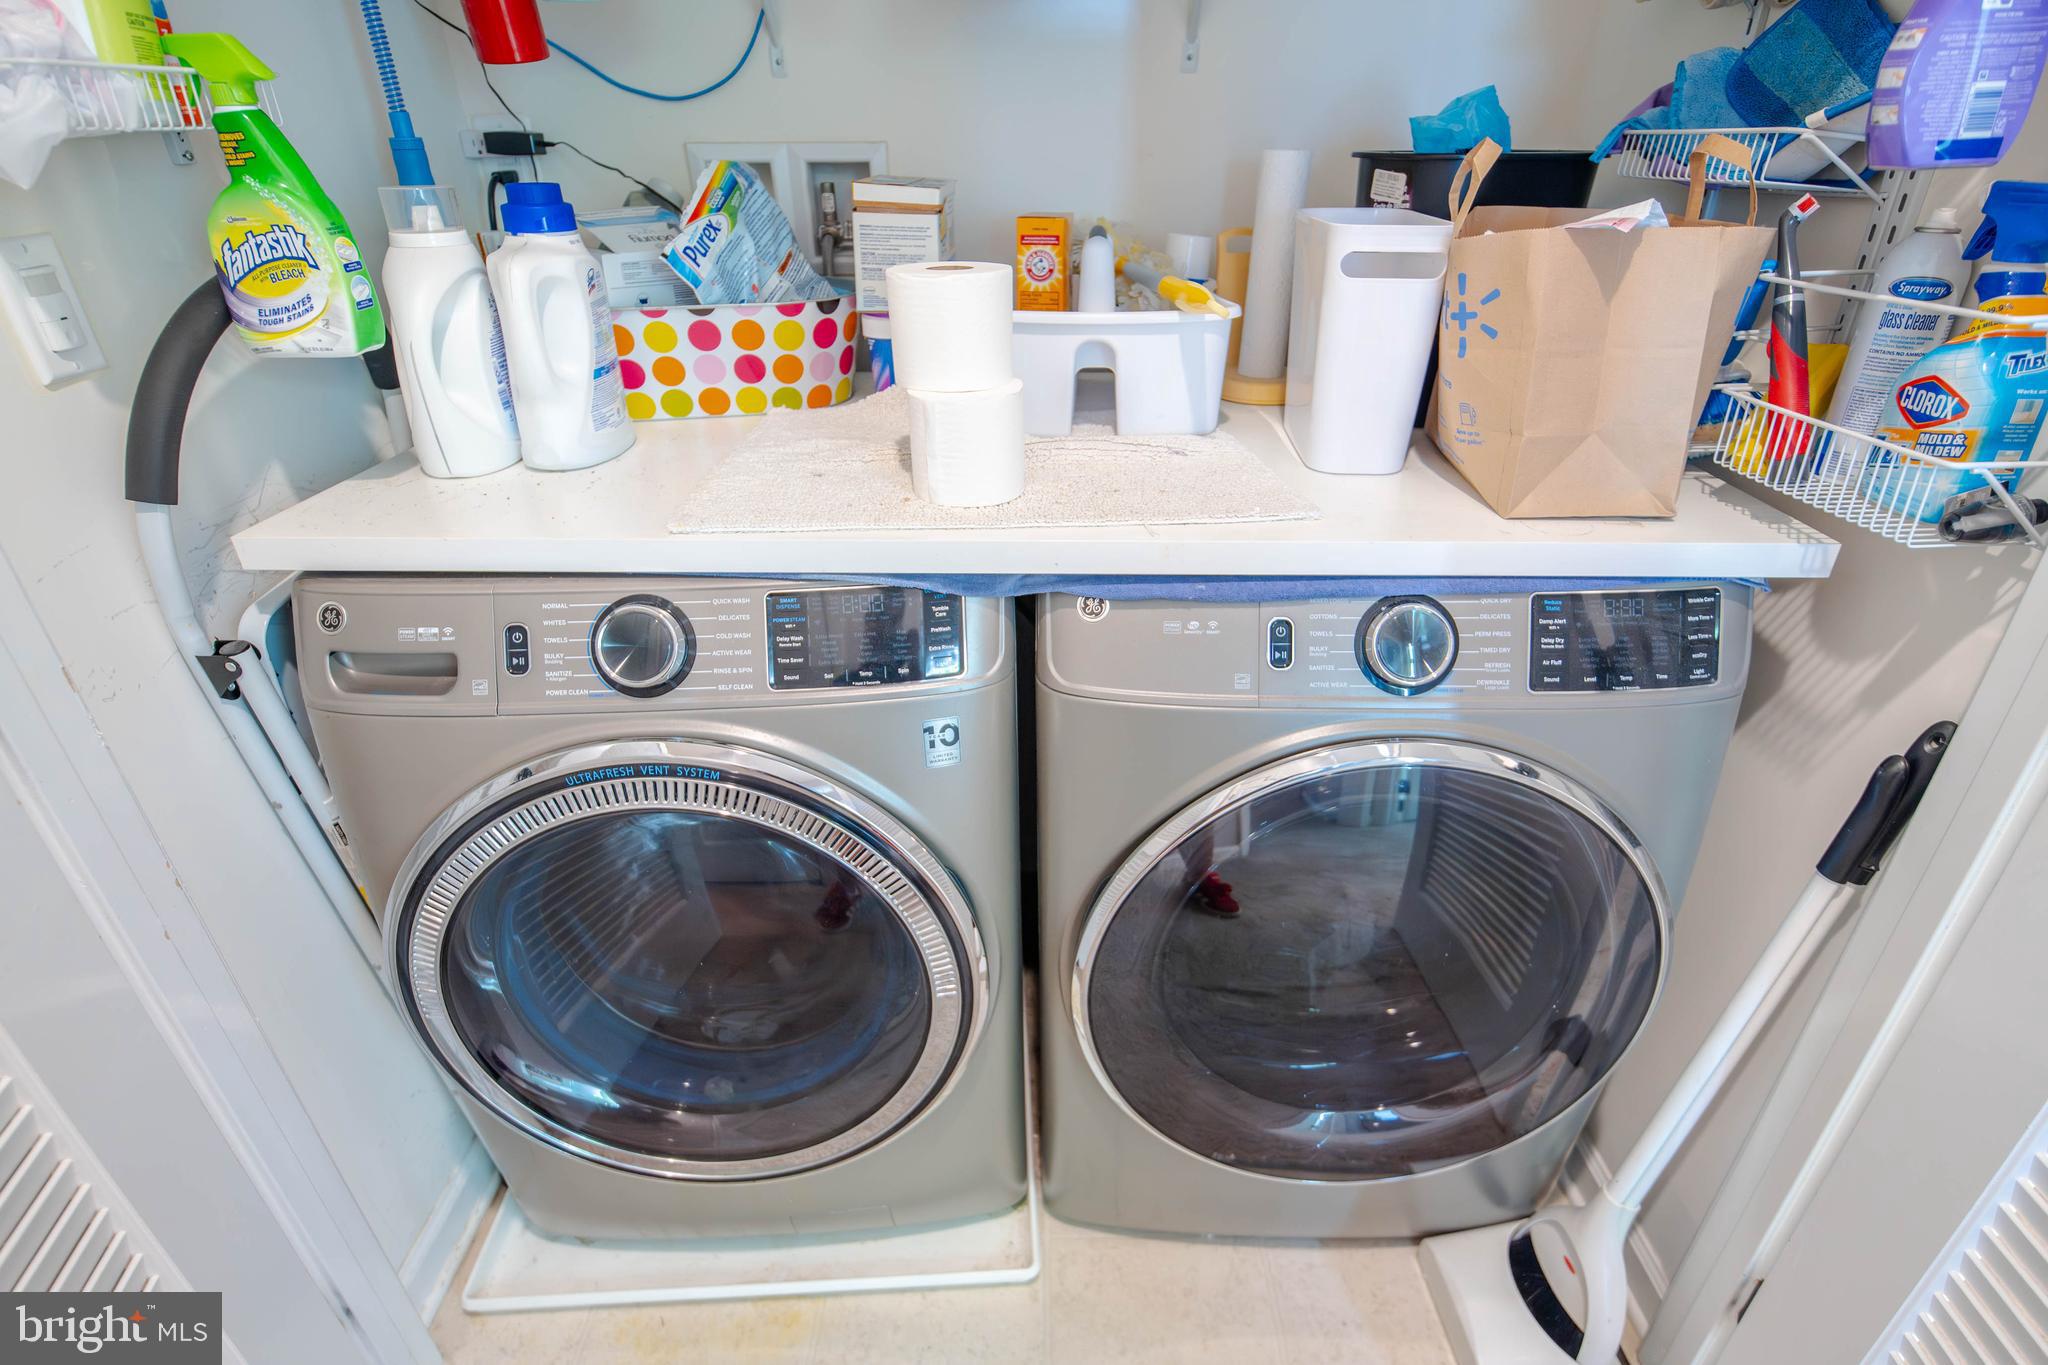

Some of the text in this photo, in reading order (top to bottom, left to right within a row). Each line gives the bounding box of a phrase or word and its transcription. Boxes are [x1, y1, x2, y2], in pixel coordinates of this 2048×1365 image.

[682, 219, 722, 267] Purex
[221, 224, 320, 293] fantastik
[269, 268, 306, 284] BLEACH
[1897, 281, 1947, 297] Sprayway
[257, 293, 312, 318] ELIMINATES
[258, 303, 315, 326] TOUGH STAINS
[1878, 309, 1941, 331] glass cleaner
[1899, 385, 1959, 420] CLOROX
[1918, 432, 1966, 445] MOLD &
[897, 667, 910, 675] Spin
[922, 723, 960, 749] 10
[565, 765, 721, 786] ULTRAFRESH VENT SYSTEM
